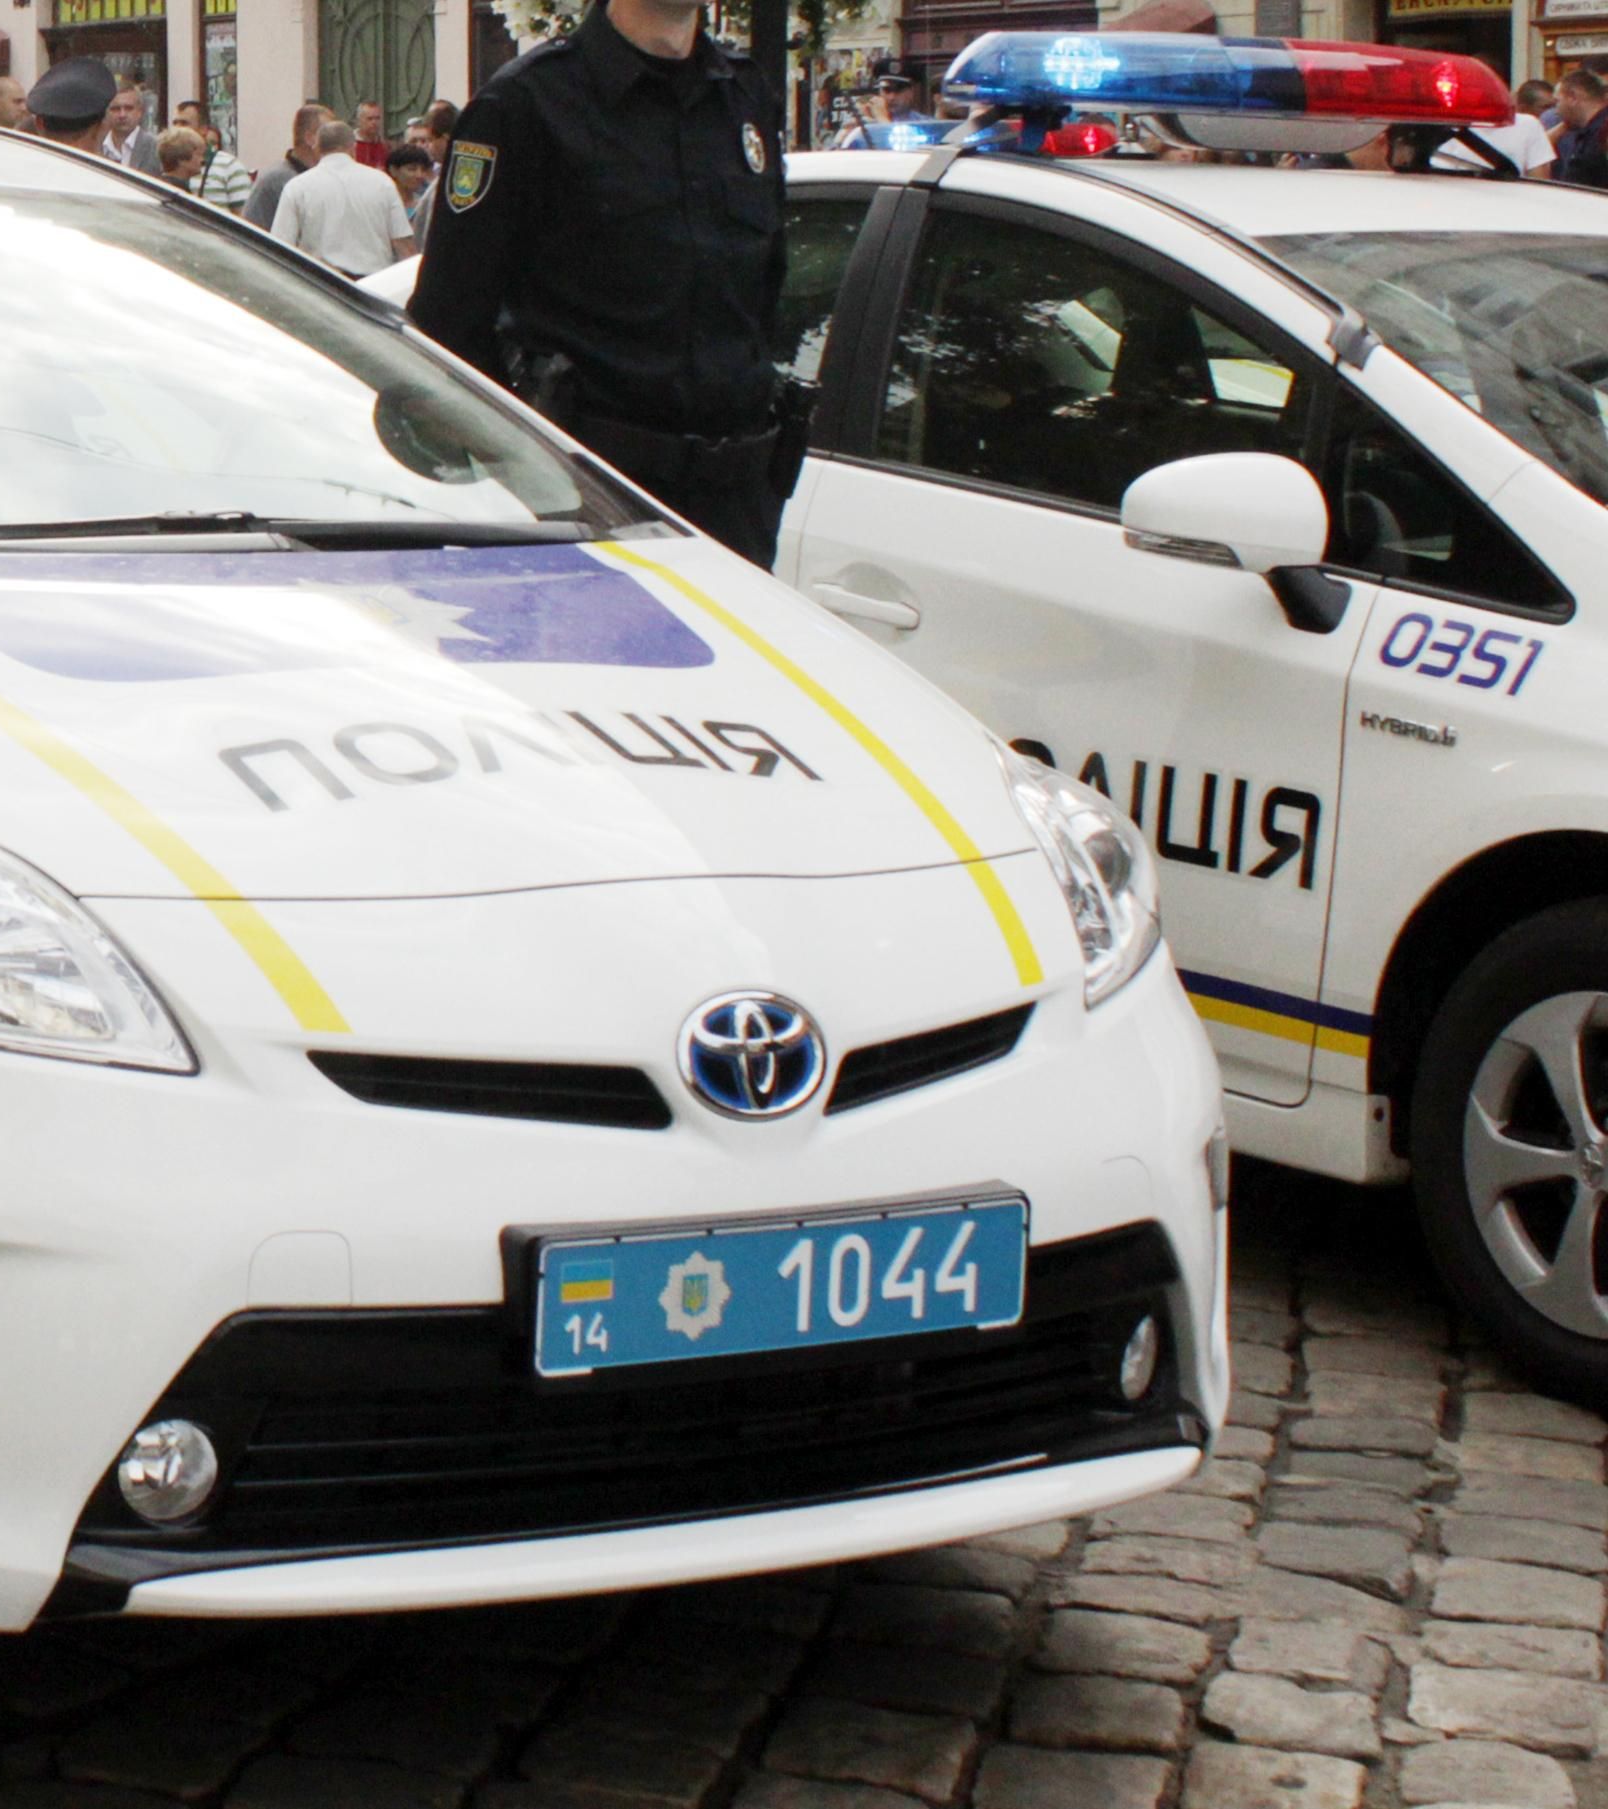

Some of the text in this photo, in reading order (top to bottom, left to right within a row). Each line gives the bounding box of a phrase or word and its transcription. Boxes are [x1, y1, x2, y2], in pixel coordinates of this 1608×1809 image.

[1380, 612, 1543, 697] 0351
[1008, 737, 1322, 891] ІЦІЯ
[778, 1220, 979, 1333] 1044
[564, 1311, 609, 1355] 14
